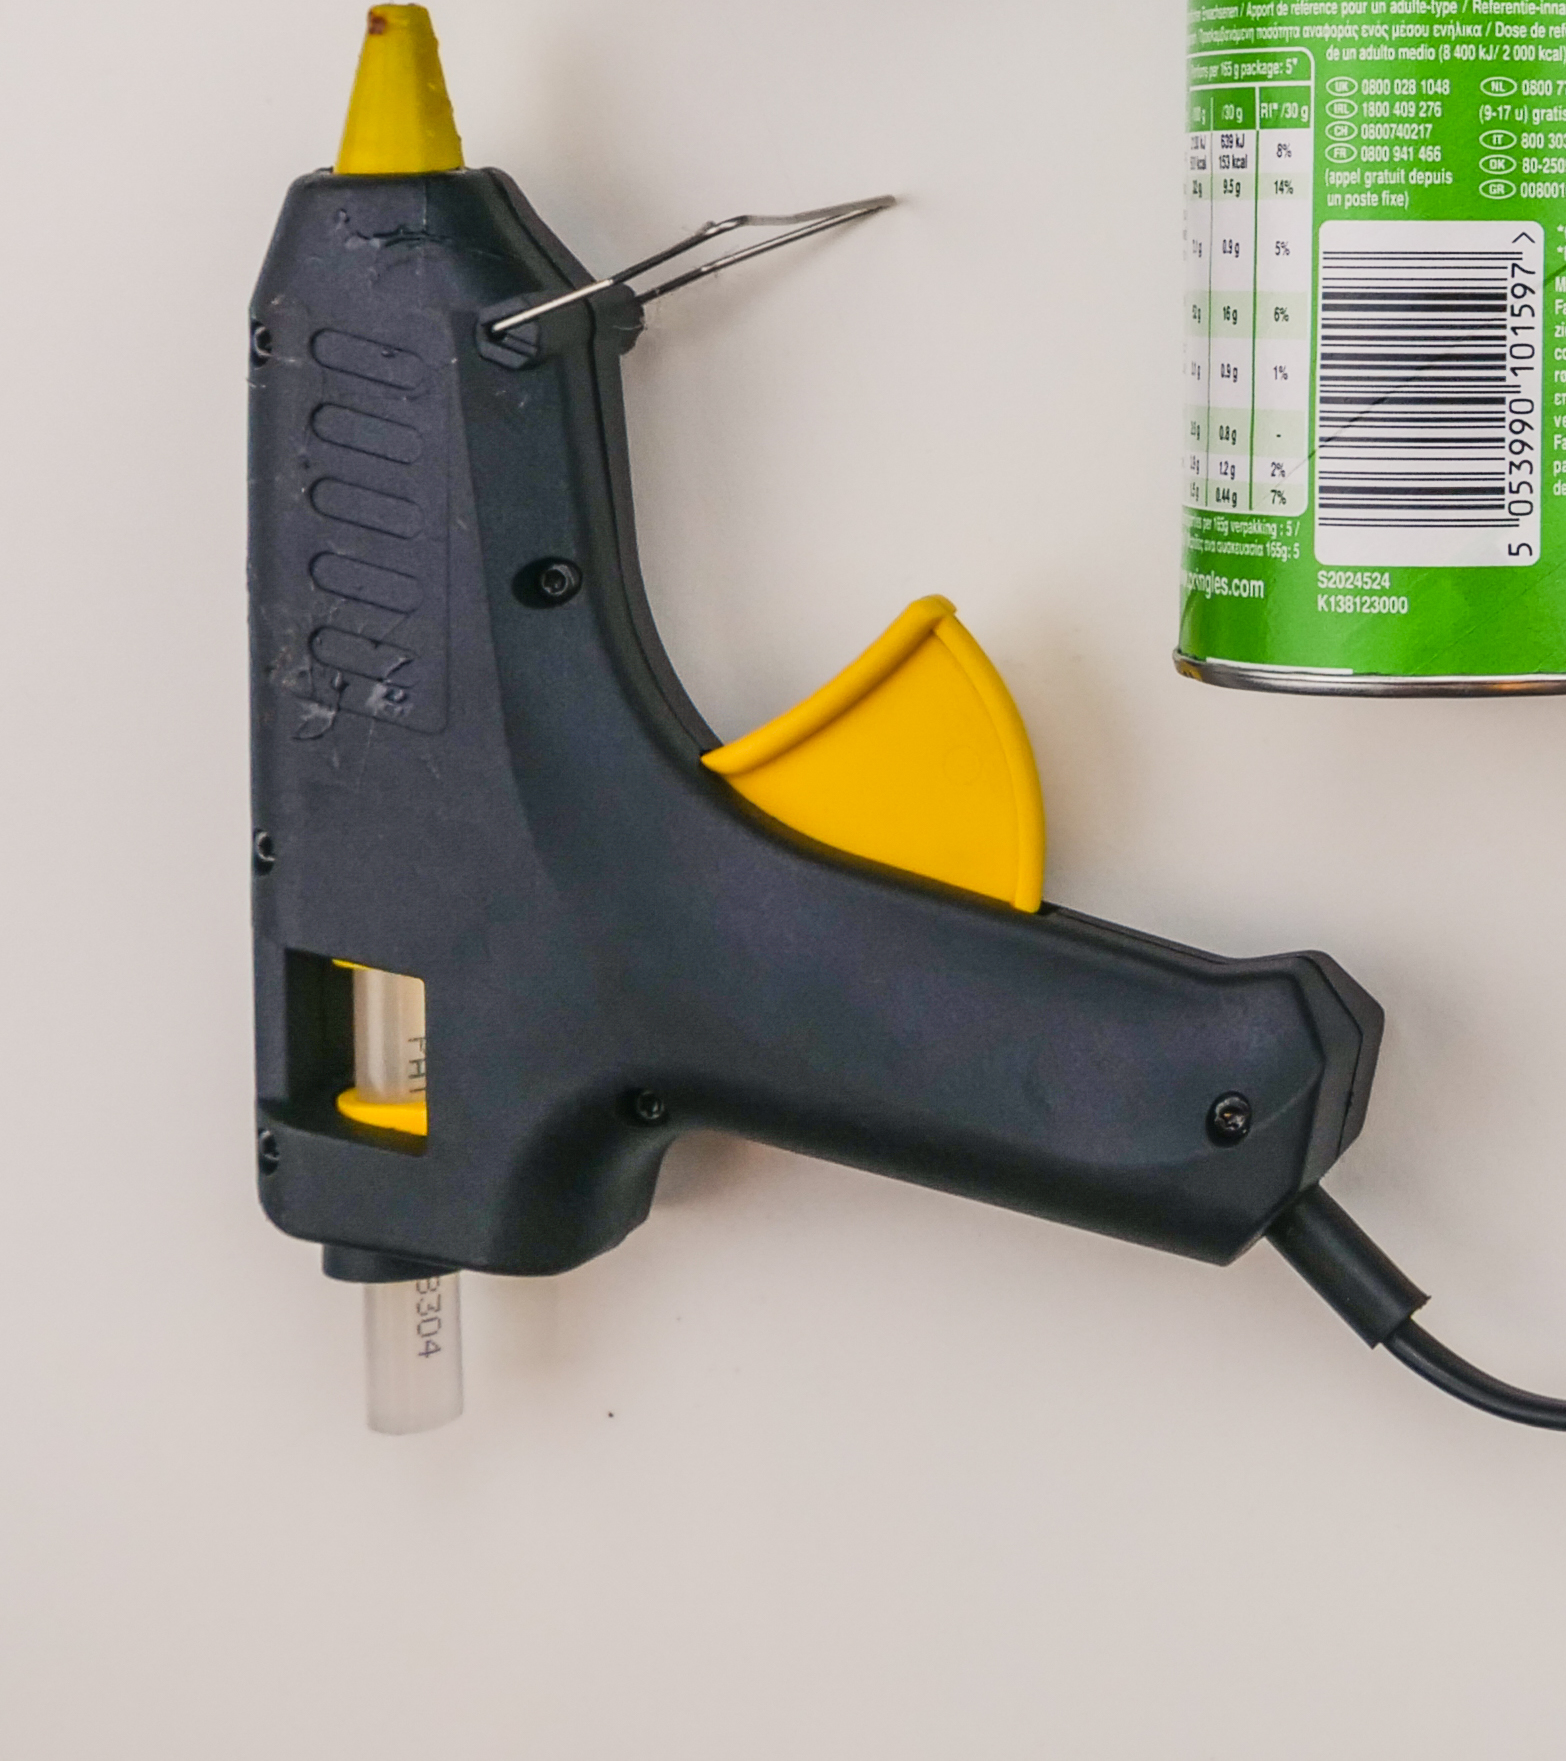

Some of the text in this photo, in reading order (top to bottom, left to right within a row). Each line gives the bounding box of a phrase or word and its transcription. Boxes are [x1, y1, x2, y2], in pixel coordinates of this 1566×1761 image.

[1361, 78, 1450, 96] 0800 028 1048
[1362, 100, 1443, 118] 1800 409 276
[1276, 142, 1293, 159] 8%
[1273, 178, 1294, 196] 14%
[1364, 168, 1454, 188] gratuit depuis
[1345, 191, 1379, 210] poste
[1273, 305, 1290, 323] 6%
[1507, 262, 1537, 557] 5 053990 101597
[1270, 488, 1287, 506] 7%
[1316, 570, 1391, 590] S2024524
[1316, 593, 1409, 614] K138123000
